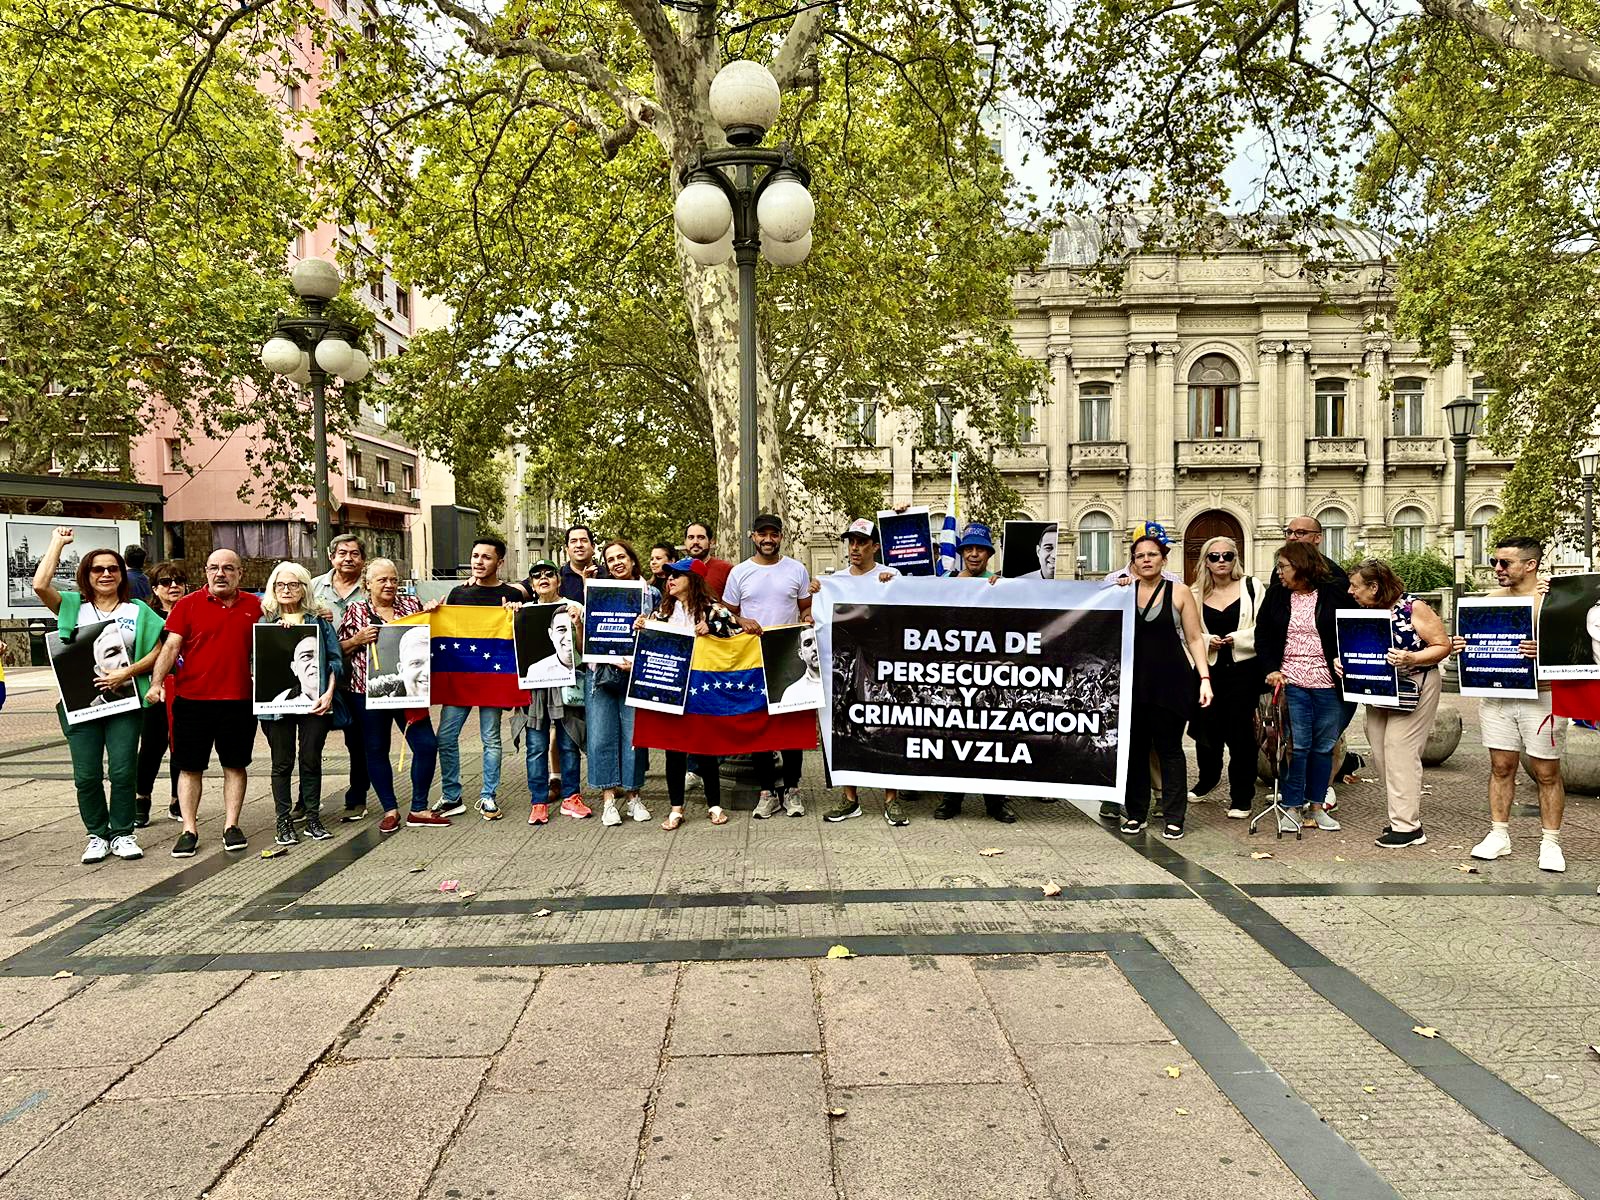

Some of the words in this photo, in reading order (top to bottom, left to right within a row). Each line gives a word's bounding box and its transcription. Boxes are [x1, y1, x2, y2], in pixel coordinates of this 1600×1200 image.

[904, 628, 997, 653] BASTA
[1005, 631, 1042, 654] DE
[878, 660, 1064, 688] PERSECUCION
[958, 687, 978, 708] Y
[848, 703, 1100, 734] CRIMINALIZACION
[906, 737, 944, 760] EN
[951, 740, 1033, 765] VZLA
